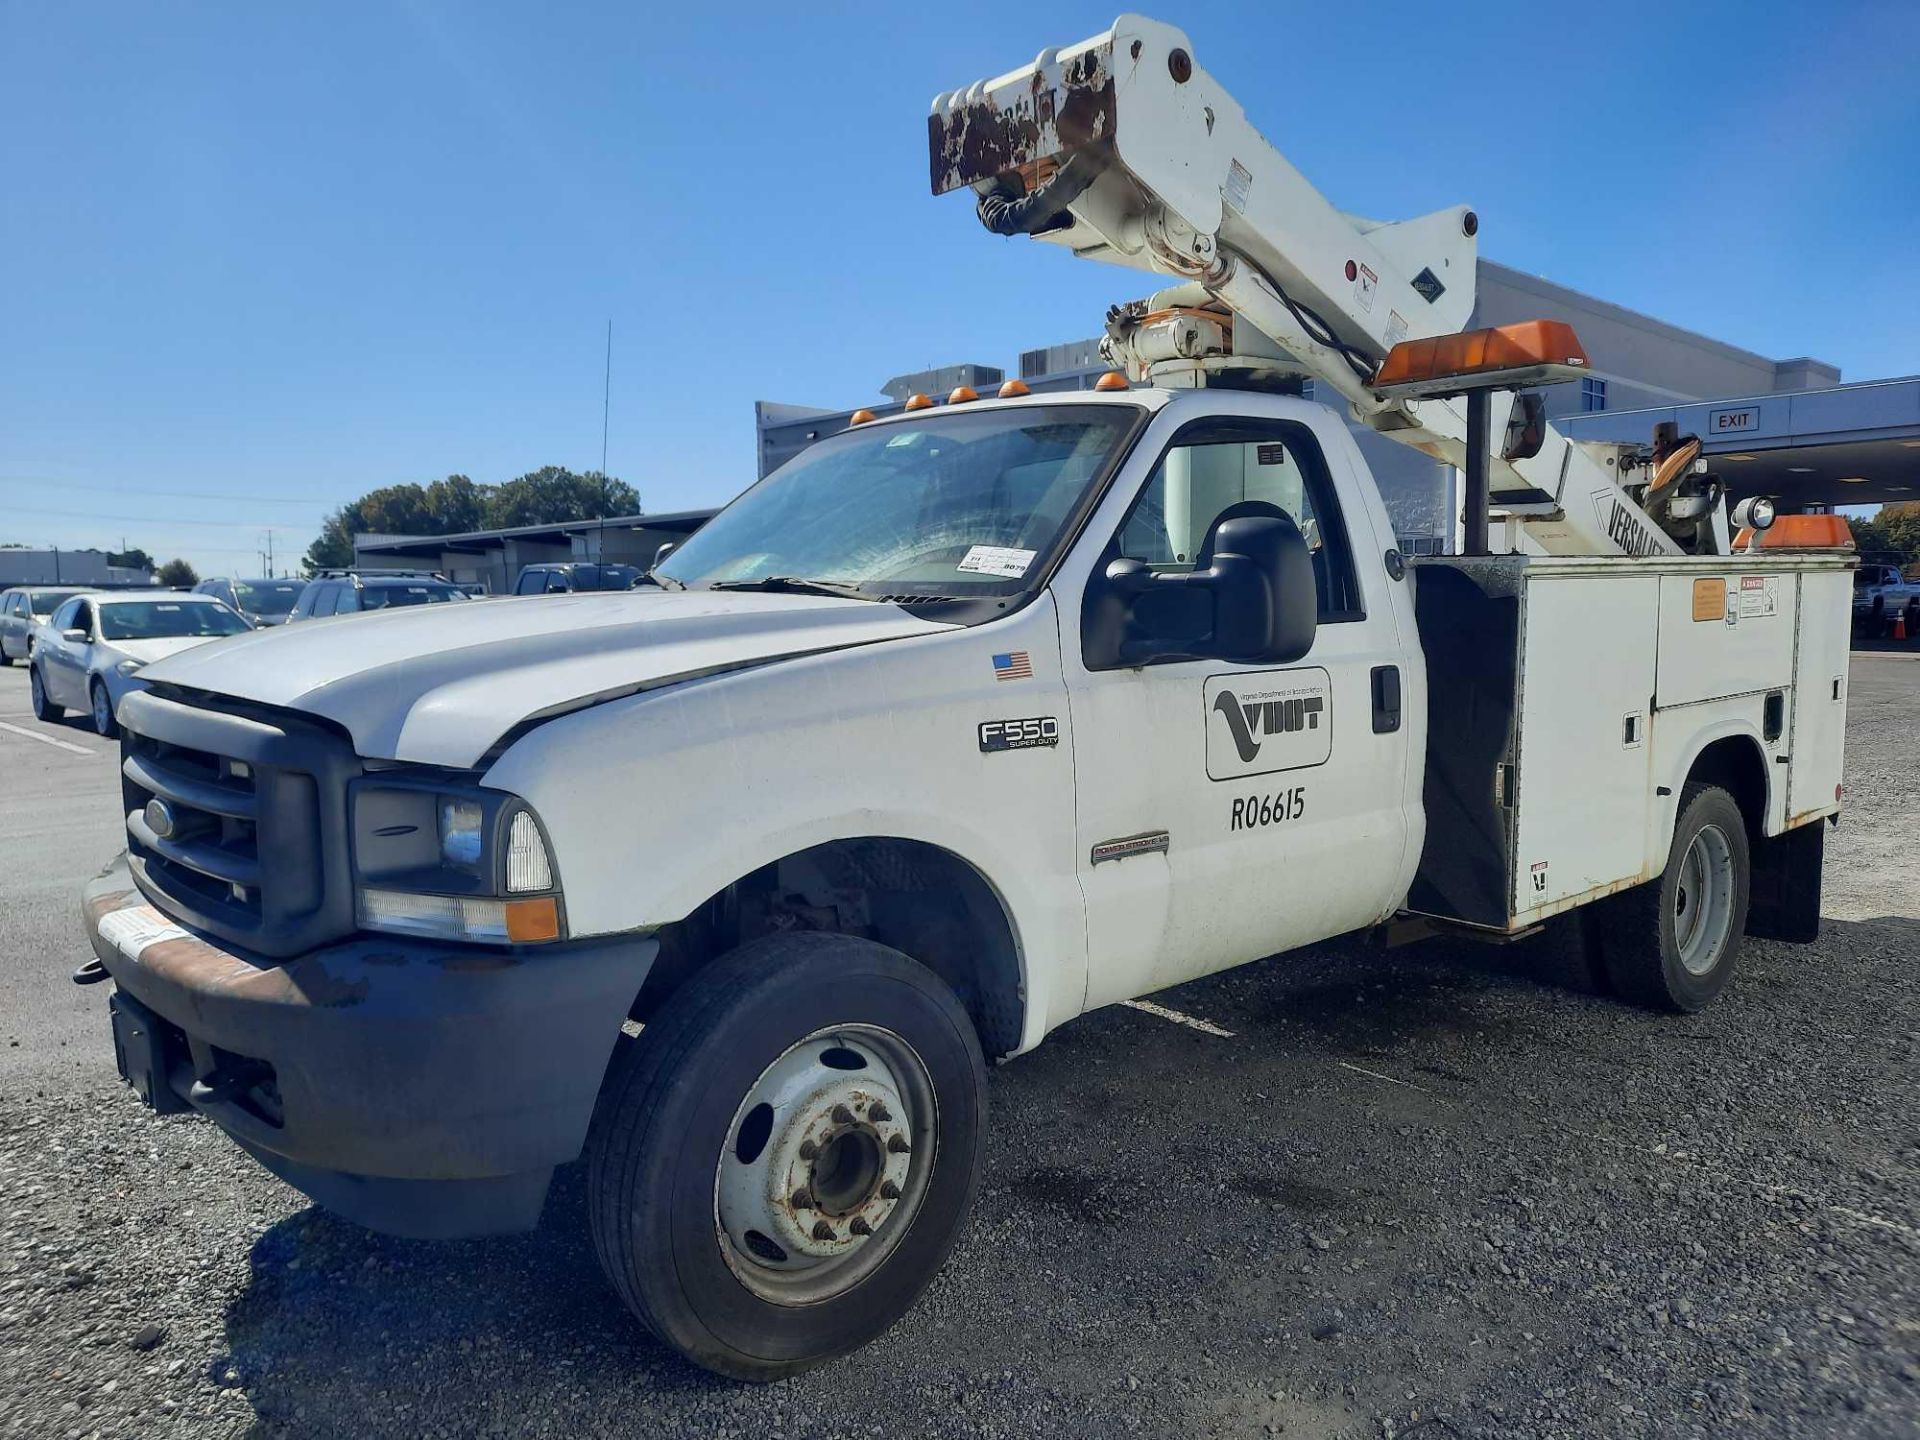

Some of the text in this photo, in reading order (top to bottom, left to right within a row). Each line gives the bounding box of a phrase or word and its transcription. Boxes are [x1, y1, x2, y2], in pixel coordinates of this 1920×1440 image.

[1719, 413, 1749, 428] EXIT
[1242, 696, 1324, 736] VDOT
[1010, 737, 1058, 748] SUPER DUTY
[1231, 787, 1305, 831] R06615
